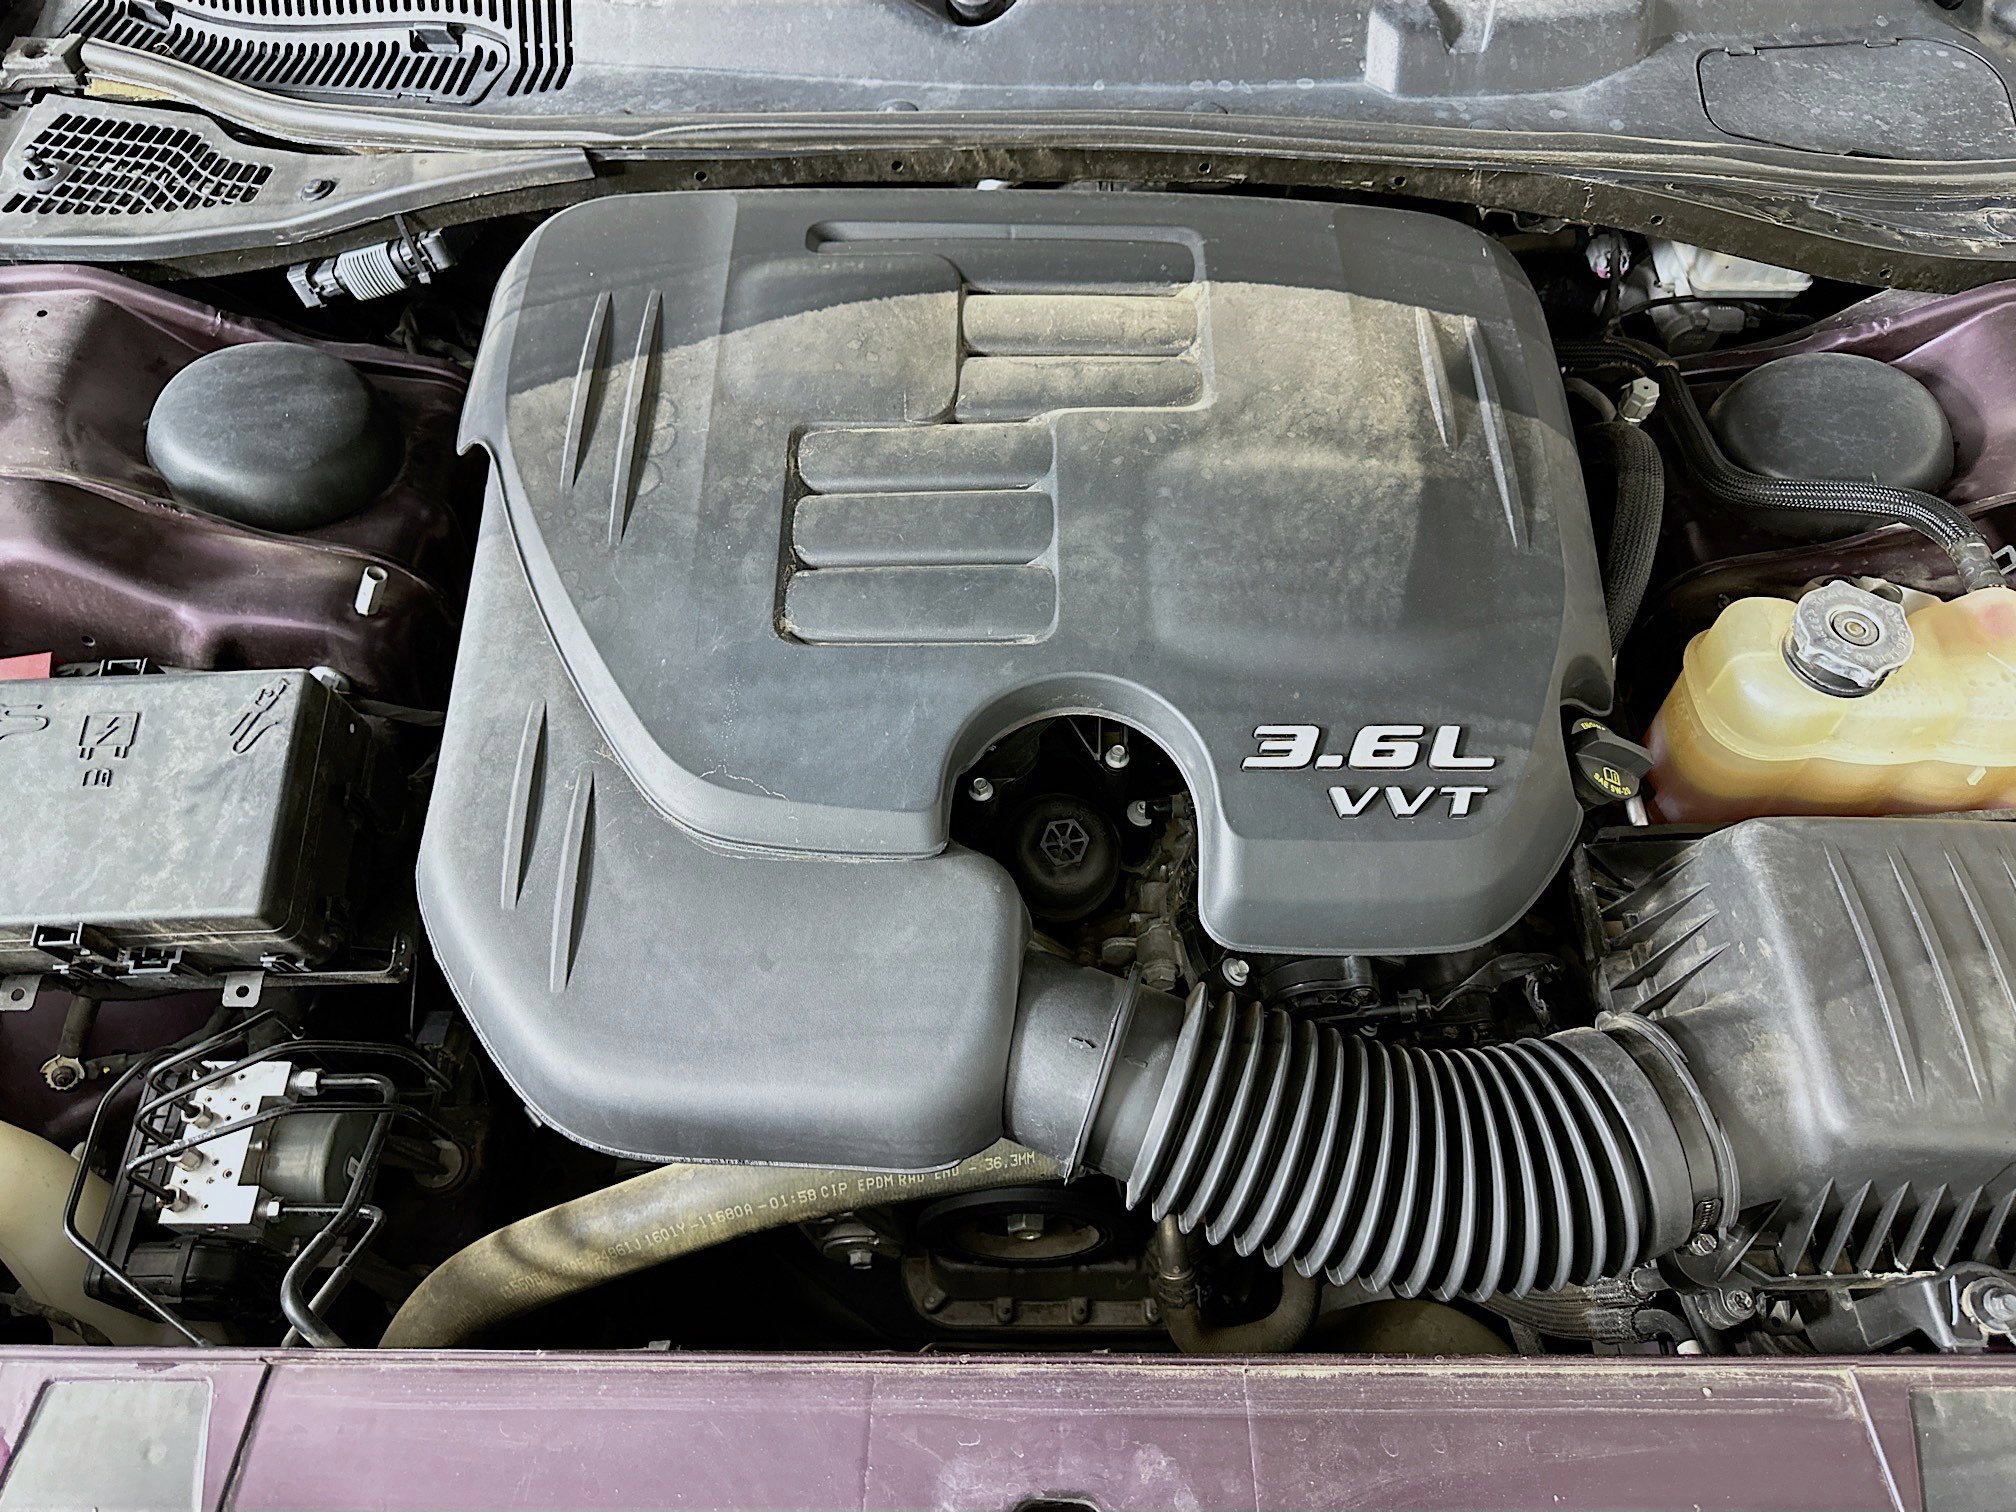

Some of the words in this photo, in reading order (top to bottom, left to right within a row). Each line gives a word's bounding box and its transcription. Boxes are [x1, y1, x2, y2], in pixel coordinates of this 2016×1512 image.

[1241, 724, 1497, 771] 3.6L
[1328, 785, 1489, 819] VVT
[1593, 772, 1609, 789] SAE
[1610, 784, 1632, 796] 5W-20
[645, 1221, 686, 1245] 1601Y
[757, 1188, 818, 1210] -01:58
[820, 1181, 848, 1199] CIP
[857, 1174, 894, 1193] EPDM
